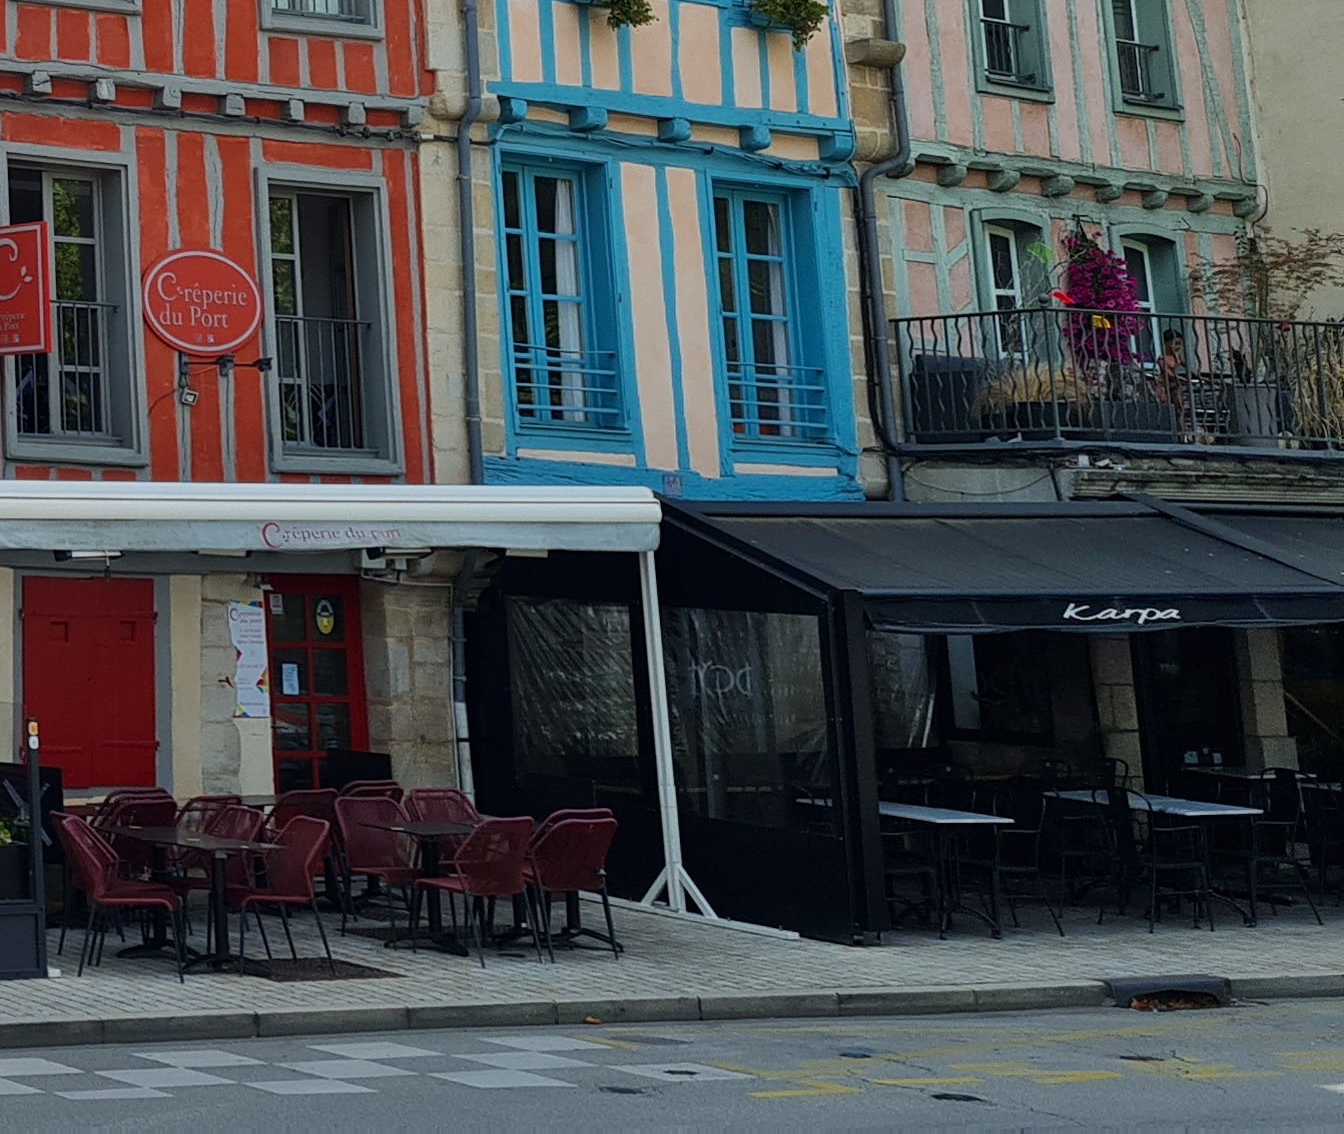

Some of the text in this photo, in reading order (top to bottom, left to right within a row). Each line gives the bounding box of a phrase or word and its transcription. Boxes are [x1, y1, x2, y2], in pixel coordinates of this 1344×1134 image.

[157, 272, 247, 310] Crêperie
[159, 303, 229, 328] du Port
[1063, 603, 1181, 624] Karpa
